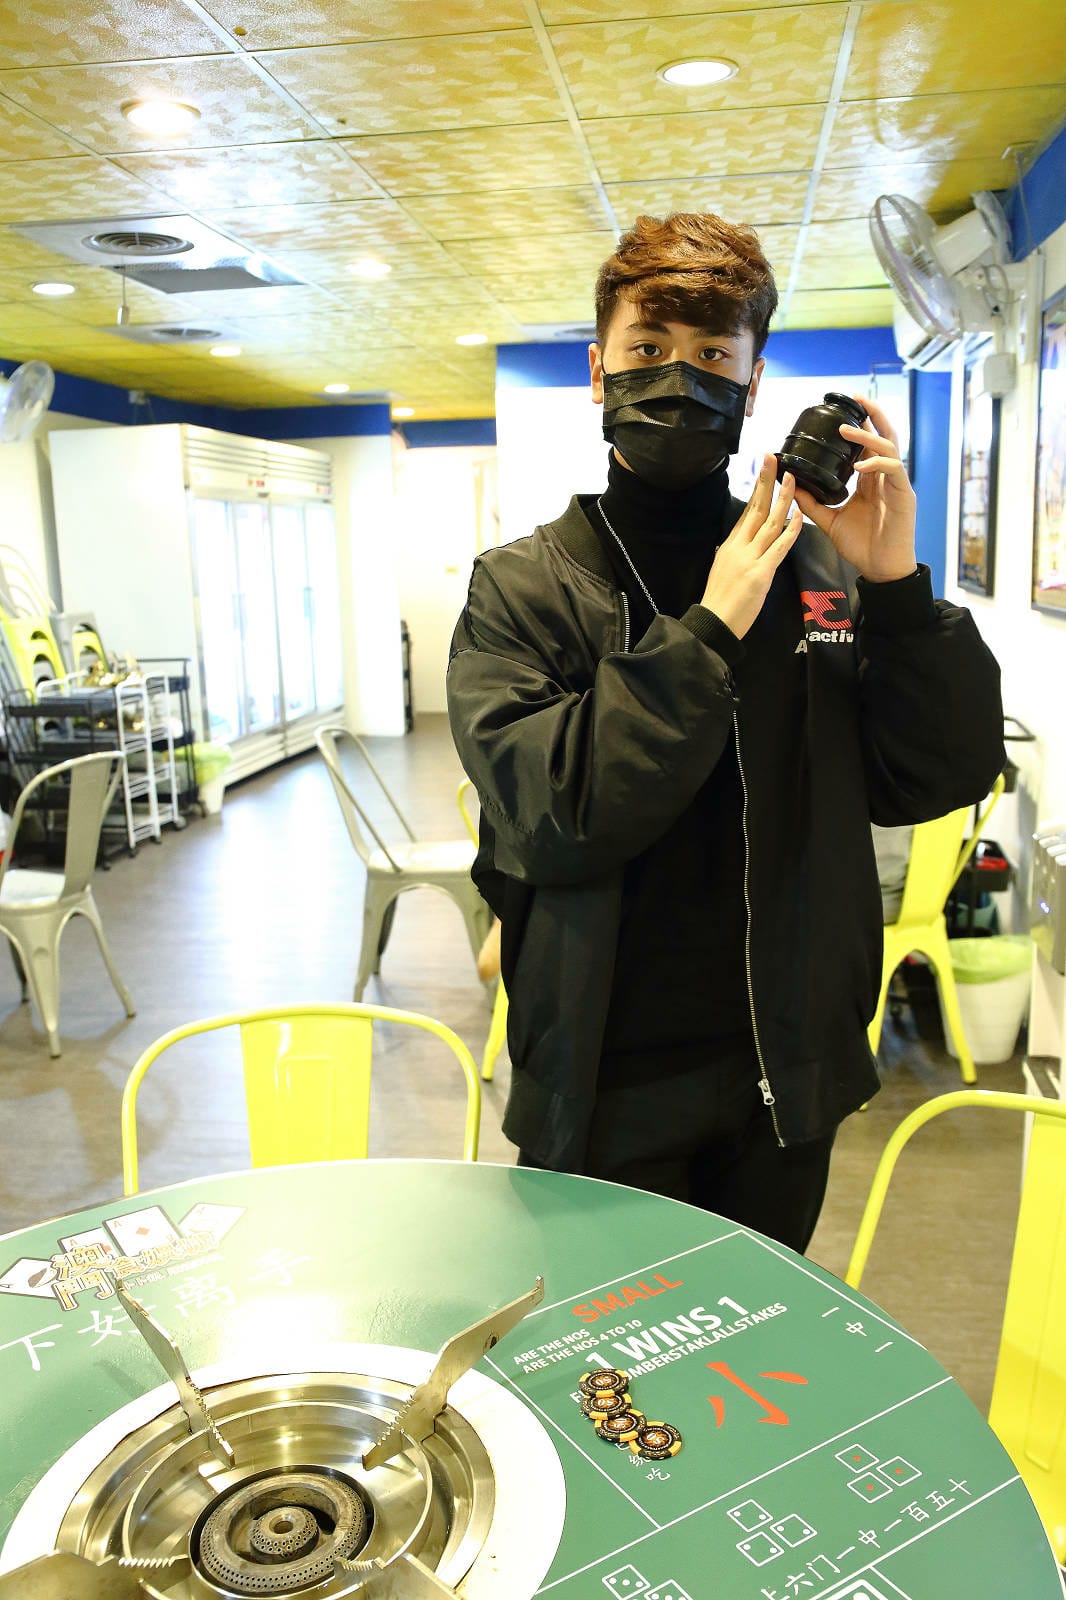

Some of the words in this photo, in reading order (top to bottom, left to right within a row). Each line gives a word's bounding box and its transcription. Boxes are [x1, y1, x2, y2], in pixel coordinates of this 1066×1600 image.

[572, 1273, 683, 1324] SMALL
[513, 1349, 540, 1365] ARE
[537, 1339, 565, 1354] THE
[562, 1328, 590, 1345] NOS
[522, 1358, 549, 1374] ARE
[546, 1347, 574, 1363] THE
[571, 1336, 600, 1353] NOS
[599, 1333, 609, 1341] 4
[606, 1326, 626, 1337] TO
[625, 1319, 642, 1330] 10
[585, 1352, 616, 1370] 1
[611, 1306, 722, 1361] WINS
[717, 1295, 749, 1316] 1
[706, 1360, 809, 1428] 小
